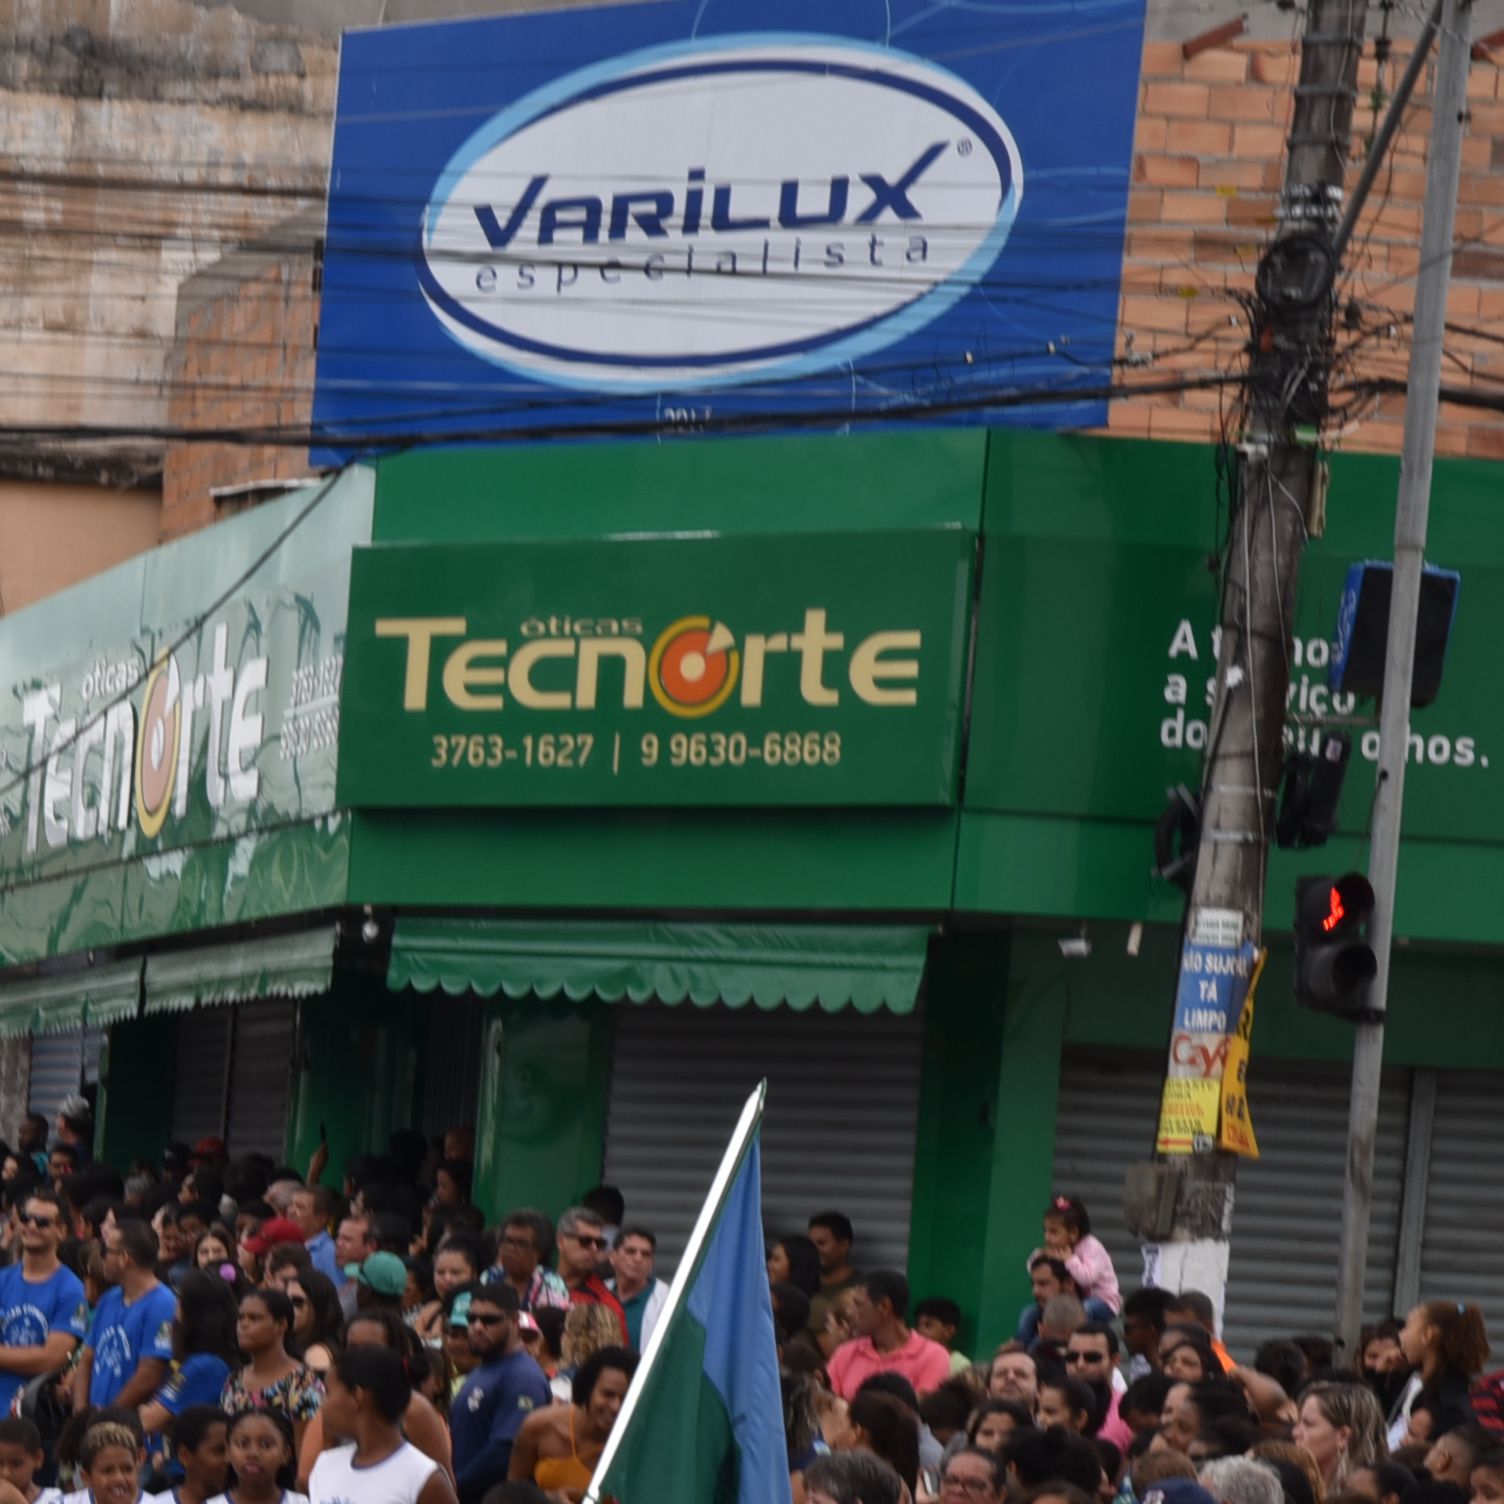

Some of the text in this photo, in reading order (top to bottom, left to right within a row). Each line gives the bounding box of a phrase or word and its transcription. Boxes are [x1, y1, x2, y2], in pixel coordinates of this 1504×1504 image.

[474, 232, 930, 294] especialista
[431, 732, 594, 768] 3763-1627
[669, 732, 842, 767] 9630-6868
